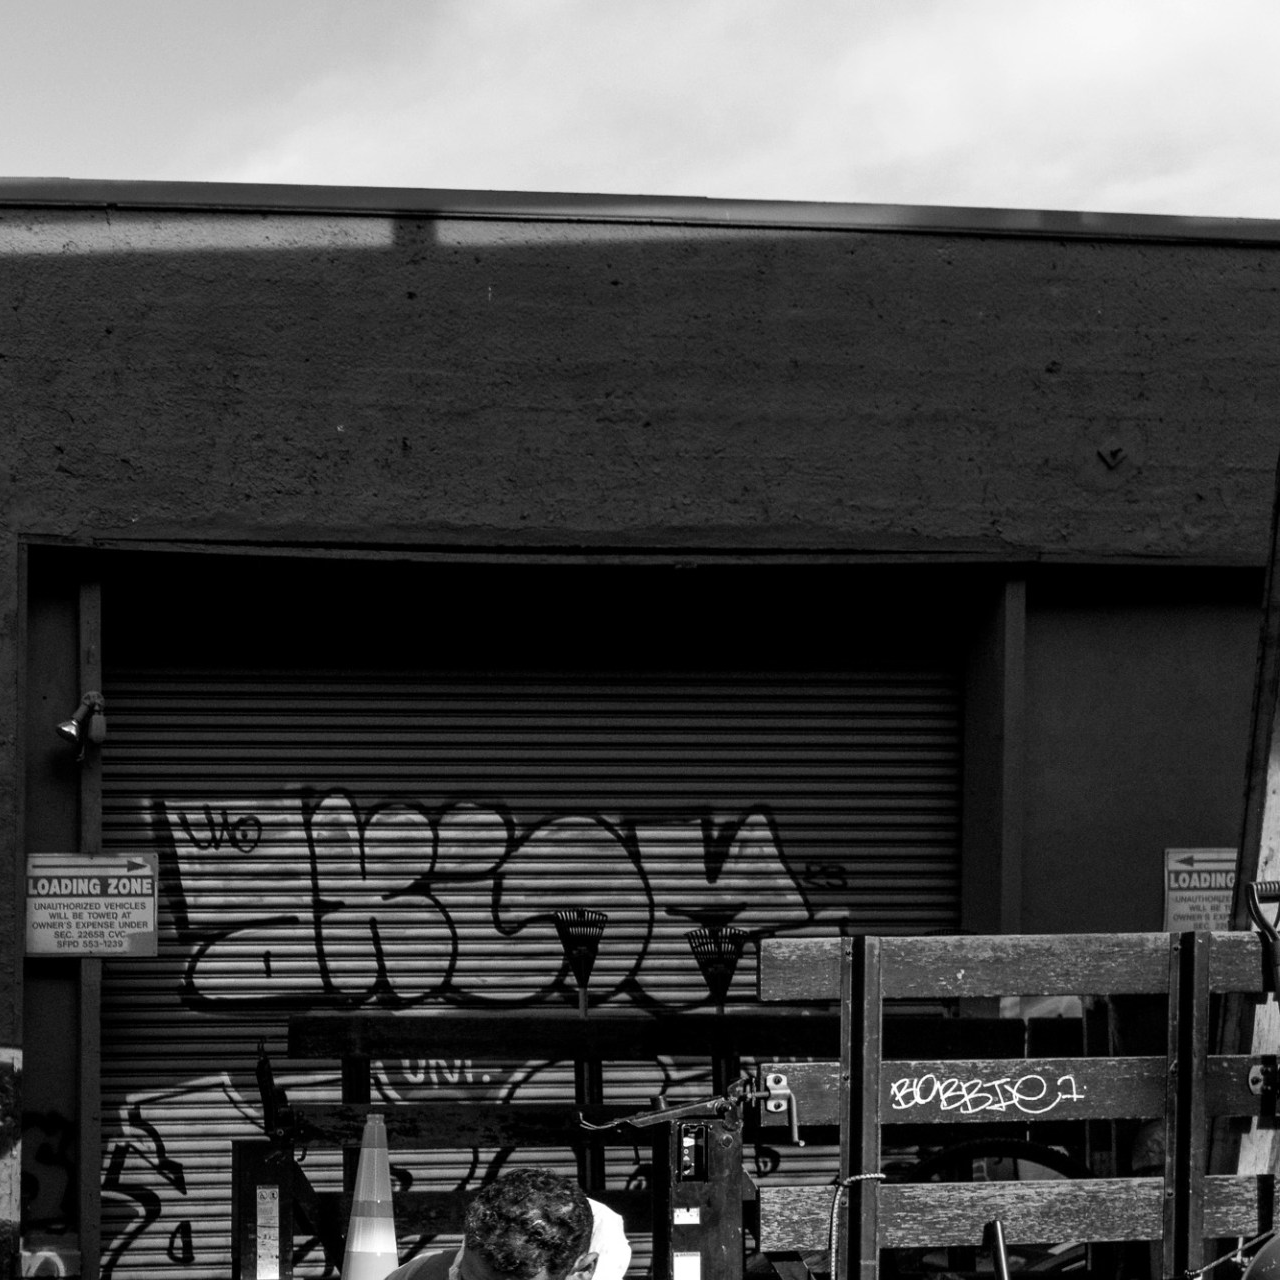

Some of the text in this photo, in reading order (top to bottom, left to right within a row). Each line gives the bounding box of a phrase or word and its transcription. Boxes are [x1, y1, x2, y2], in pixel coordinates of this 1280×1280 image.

[1169, 871, 1236, 889] LOADING
[28, 877, 153, 895] LOADING ZONE
[33, 902, 147, 911] UNAUTHORIZED VEHICLES
[48, 912, 132, 921] WILL BE TOWED AT
[31, 921, 149, 930] OWNER'S EXPENSE UNDER
[54, 930, 75, 939] SEC.
[108, 930, 127, 939] CVC
[56, 940, 124, 949] SFPD 553-1239
